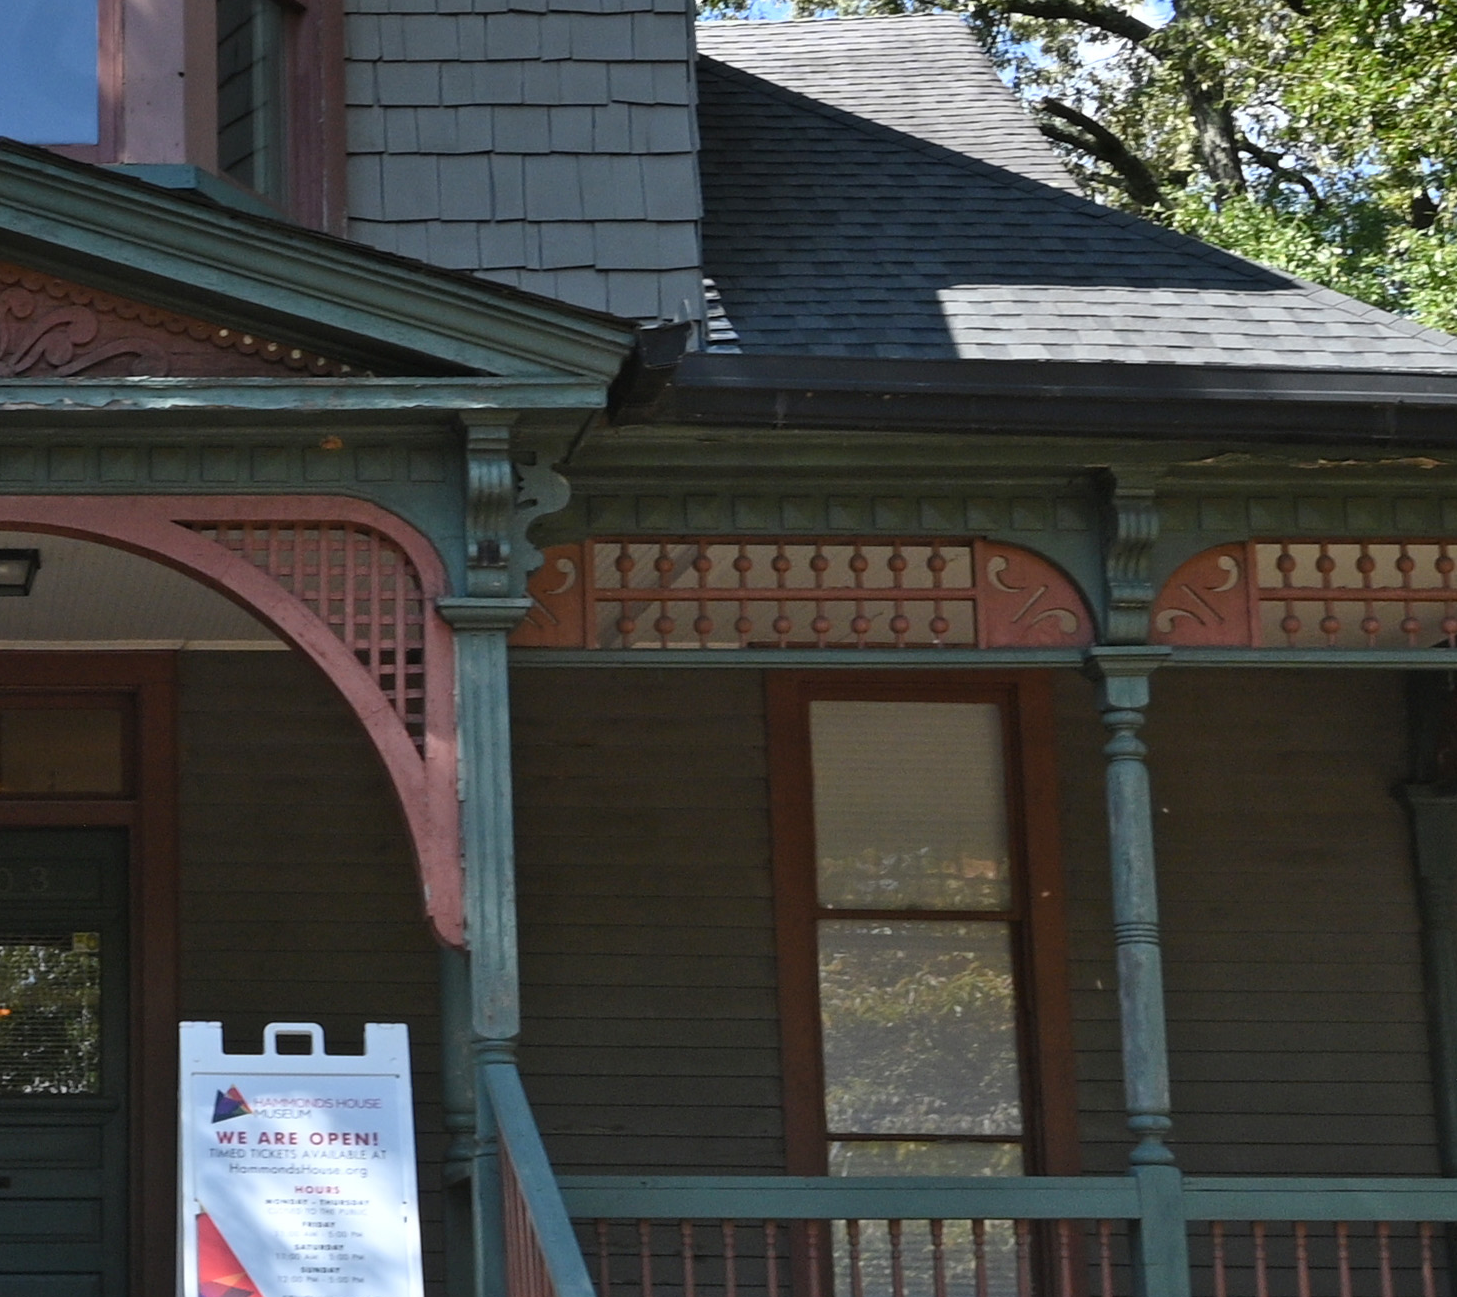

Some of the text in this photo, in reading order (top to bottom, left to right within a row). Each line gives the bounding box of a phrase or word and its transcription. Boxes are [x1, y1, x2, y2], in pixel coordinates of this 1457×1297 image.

[253, 1098, 382, 1109] HAMMONDS HOUSE
[254, 1109, 312, 1119] MUSEUM
[217, 1131, 379, 1145] WE ARE OPEN!
[210, 1148, 387, 1160] TIMED TICKETS AVAILABLE AT
[229, 1164, 368, 1178] HammondsHouse.org
[294, 1186, 341, 1194] HOURS
